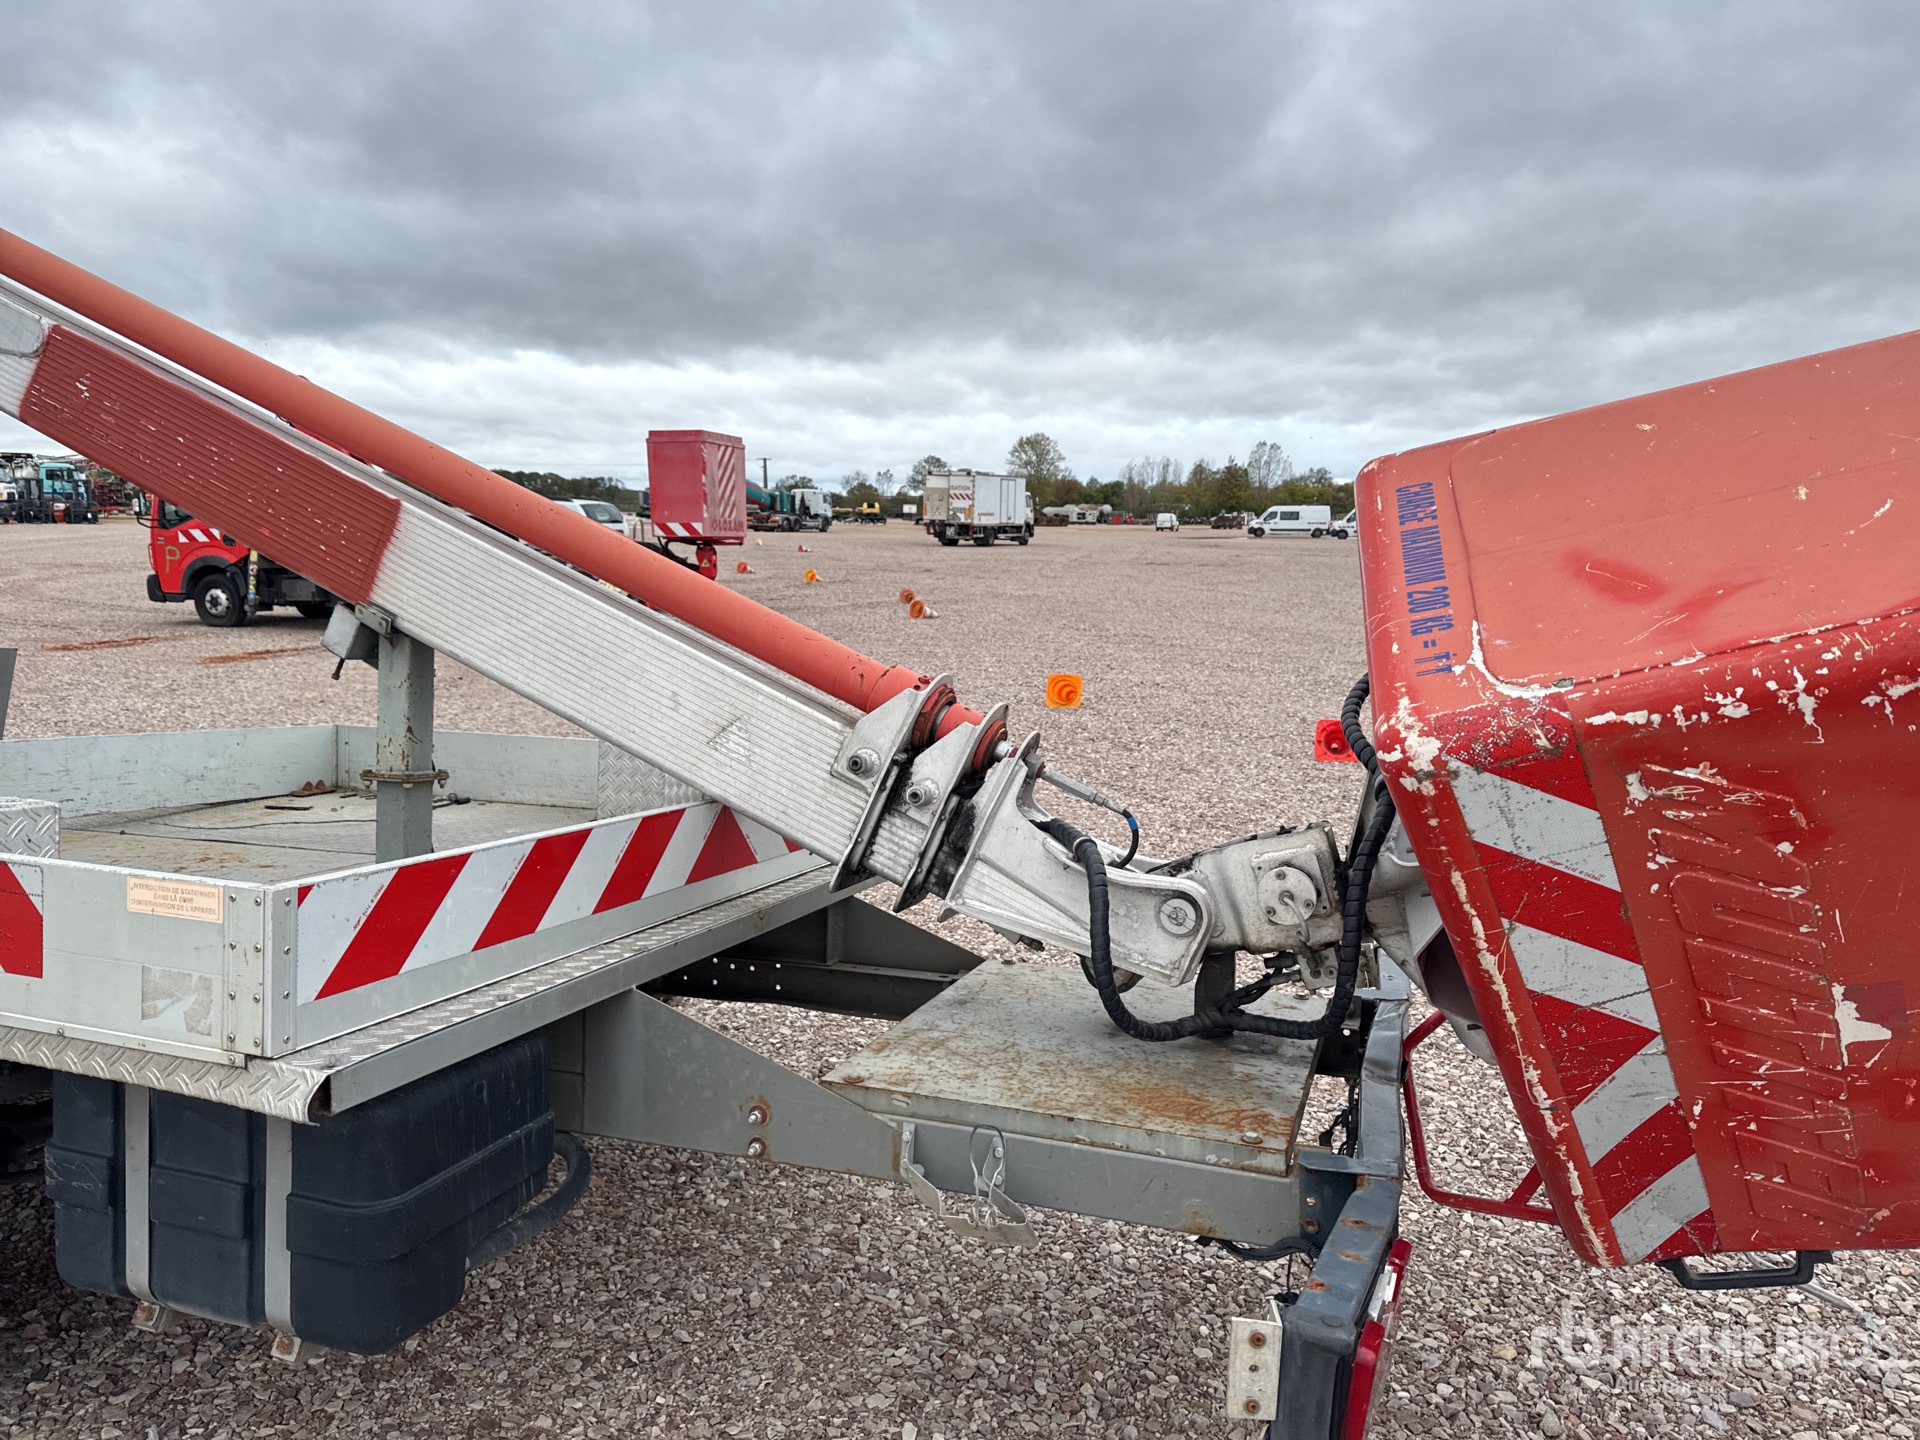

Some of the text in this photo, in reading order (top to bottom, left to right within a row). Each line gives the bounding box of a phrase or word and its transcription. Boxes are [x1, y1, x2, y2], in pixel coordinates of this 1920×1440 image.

[1395, 482, 1438, 526] CHARGE
[1400, 525, 1447, 586] MAXIMUM
[1407, 585, 1451, 613] 200
[1410, 614, 1454, 636] KG
[132, 883, 172, 894] INTERDICTION
[180, 888, 216, 898] STATIONNER
[153, 893, 169, 901] DANS
[178, 896, 194, 905] ZONE
[131, 899, 217, 915] D'INTERVENTION DE L'APPAREIL
